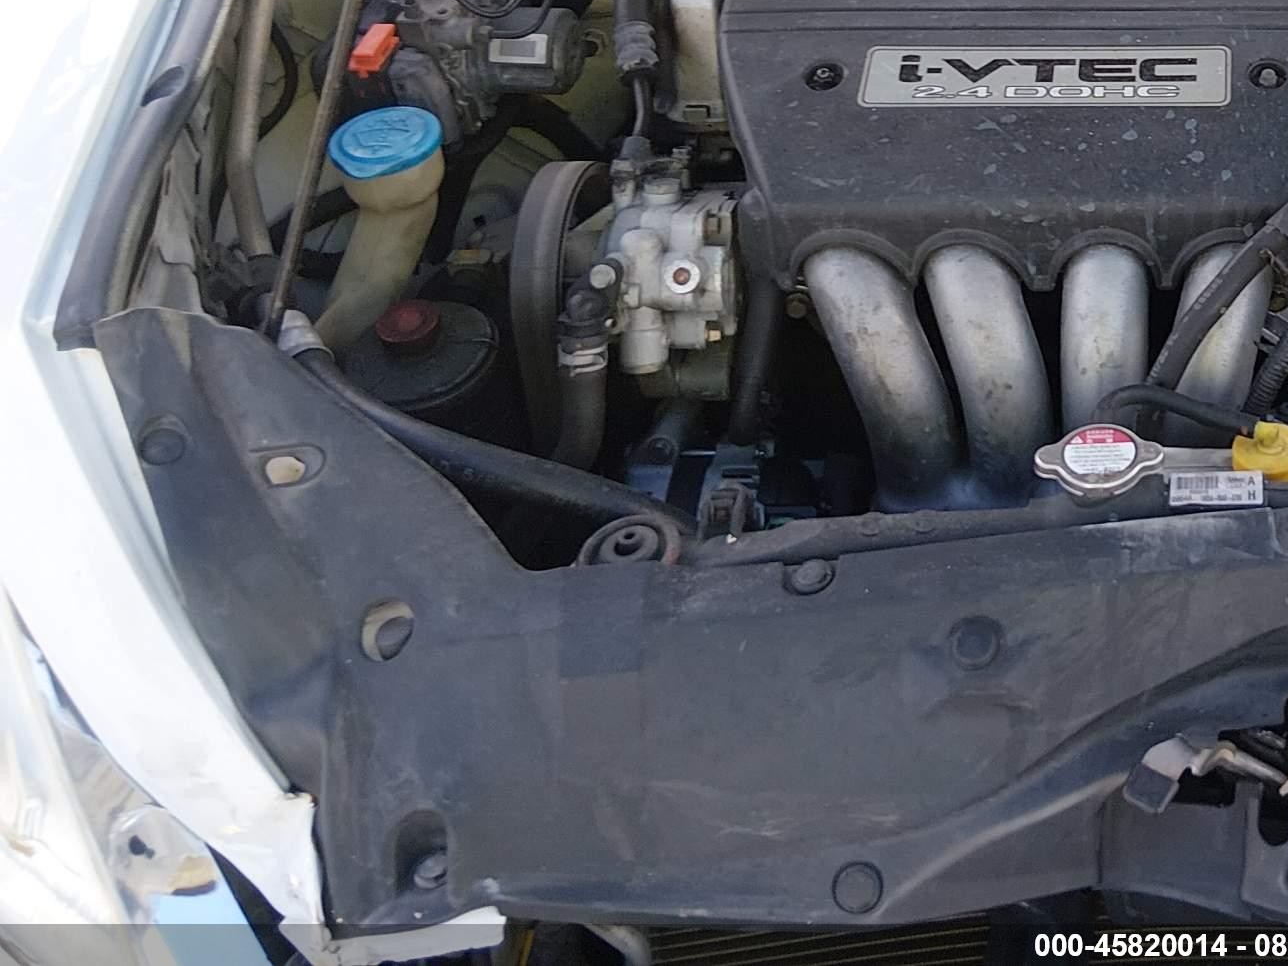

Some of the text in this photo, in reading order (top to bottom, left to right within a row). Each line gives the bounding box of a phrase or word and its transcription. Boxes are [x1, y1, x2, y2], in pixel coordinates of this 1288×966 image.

[899, 54, 1197, 83] i-VTEC
[912, 85, 1180, 99] 2.4 DOHC
[1247, 476, 1256, 485] A
